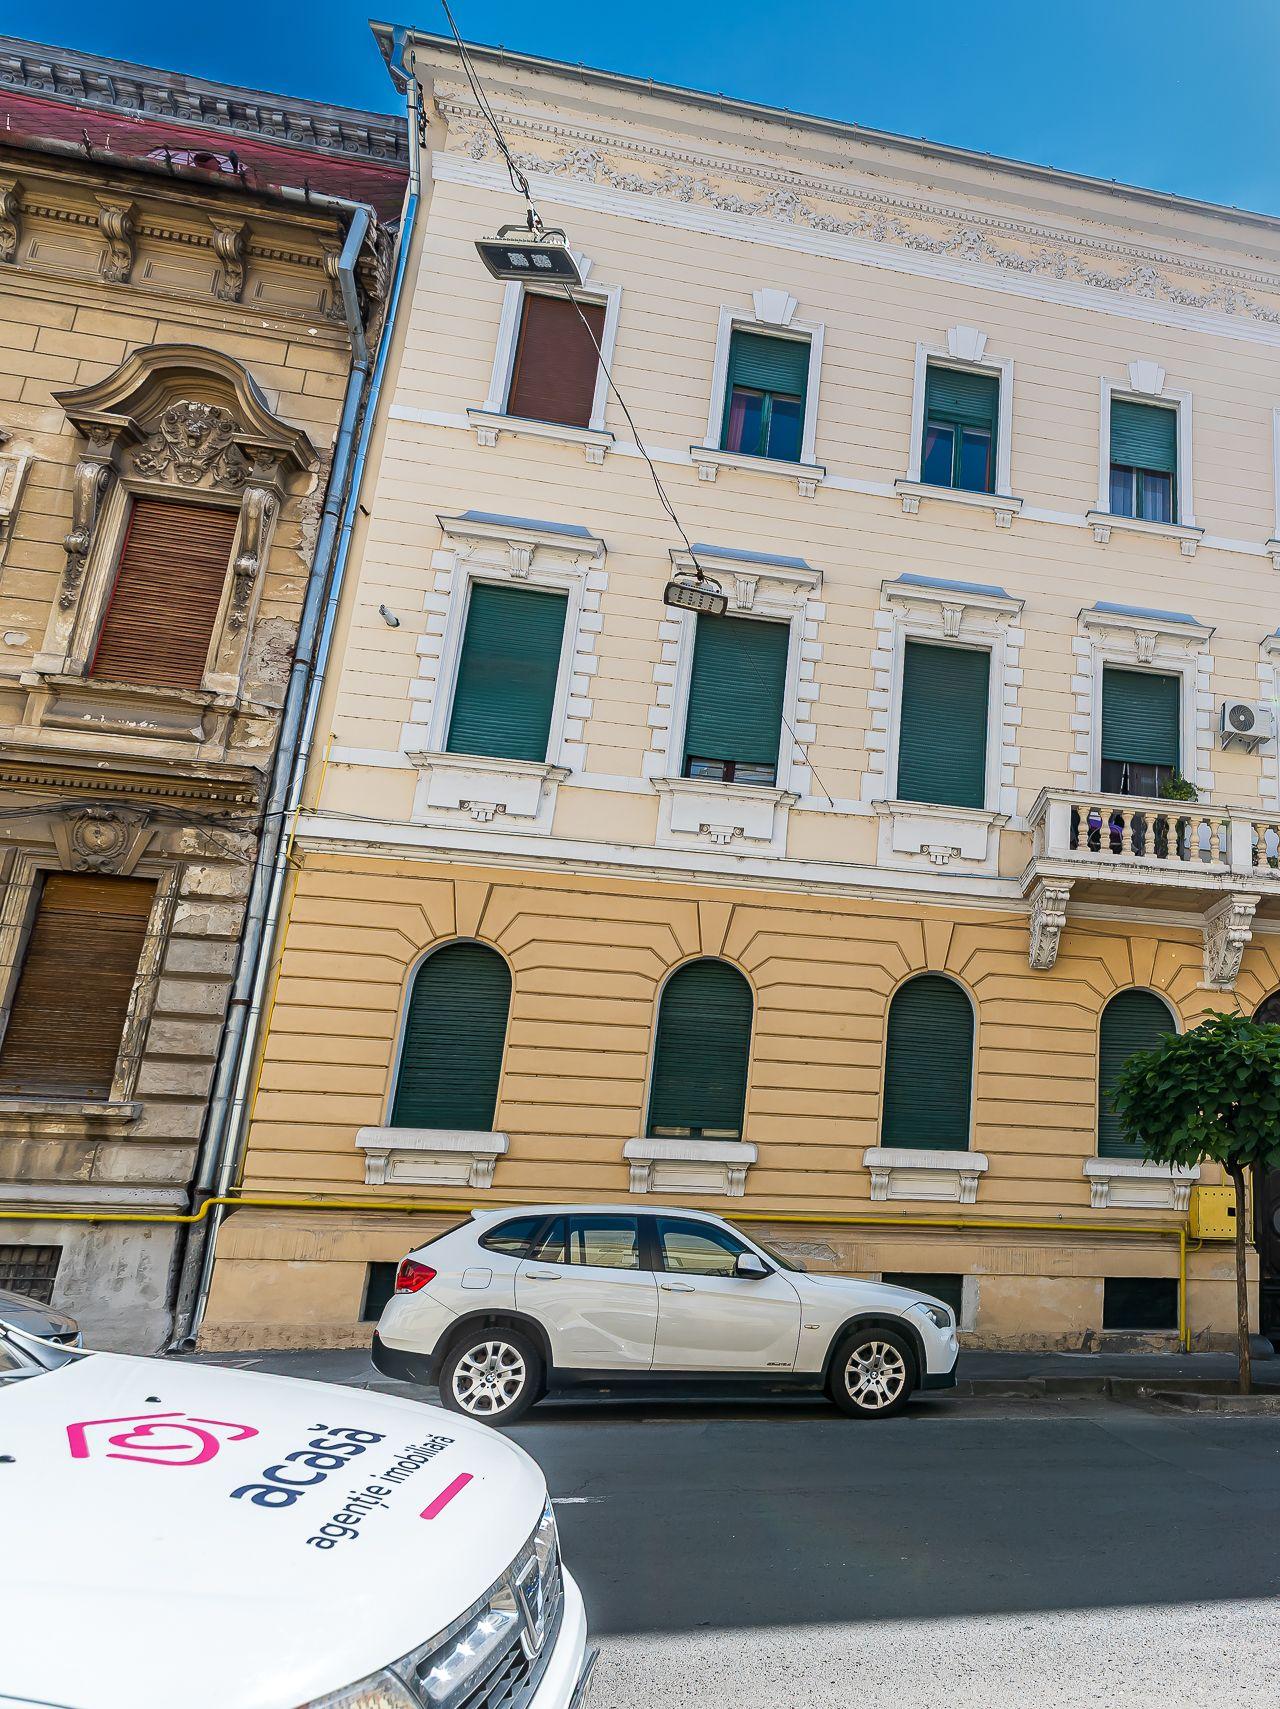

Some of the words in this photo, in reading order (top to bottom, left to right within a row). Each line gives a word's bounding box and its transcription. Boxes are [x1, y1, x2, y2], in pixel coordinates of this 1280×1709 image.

[229, 1423, 386, 1508] acasă
[306, 1484, 392, 1550] agenție
[370, 1433, 456, 1484] imobiliară
